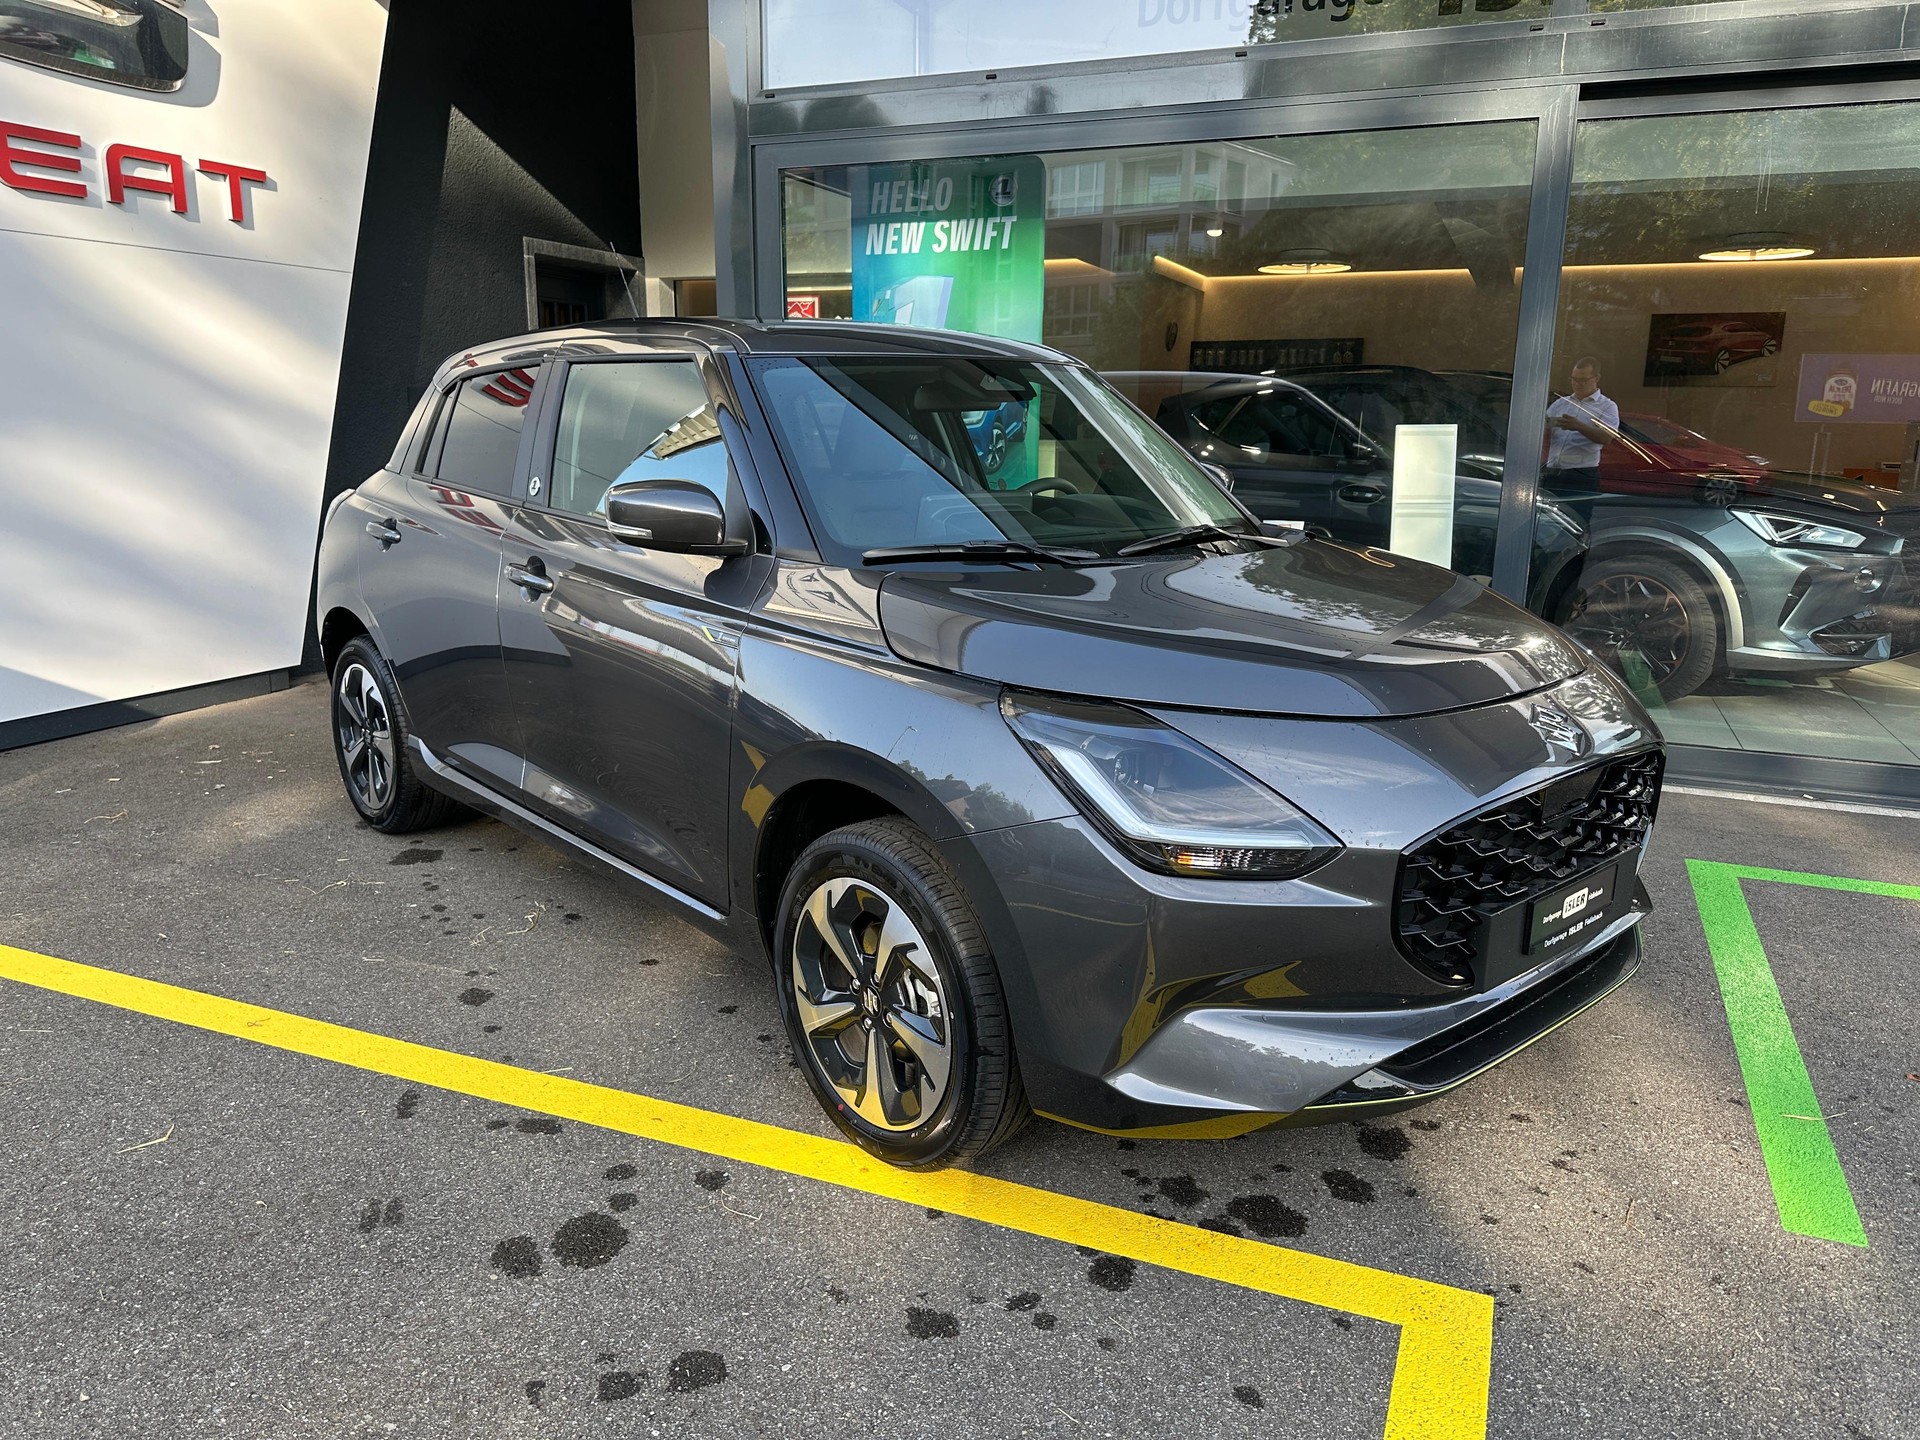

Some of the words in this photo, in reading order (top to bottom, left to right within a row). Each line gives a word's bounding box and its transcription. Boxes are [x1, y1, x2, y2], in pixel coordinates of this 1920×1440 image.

[870, 177, 953, 214] HELLO
[865, 221, 926, 255] NEW
[931, 215, 1017, 253] SWIFT
